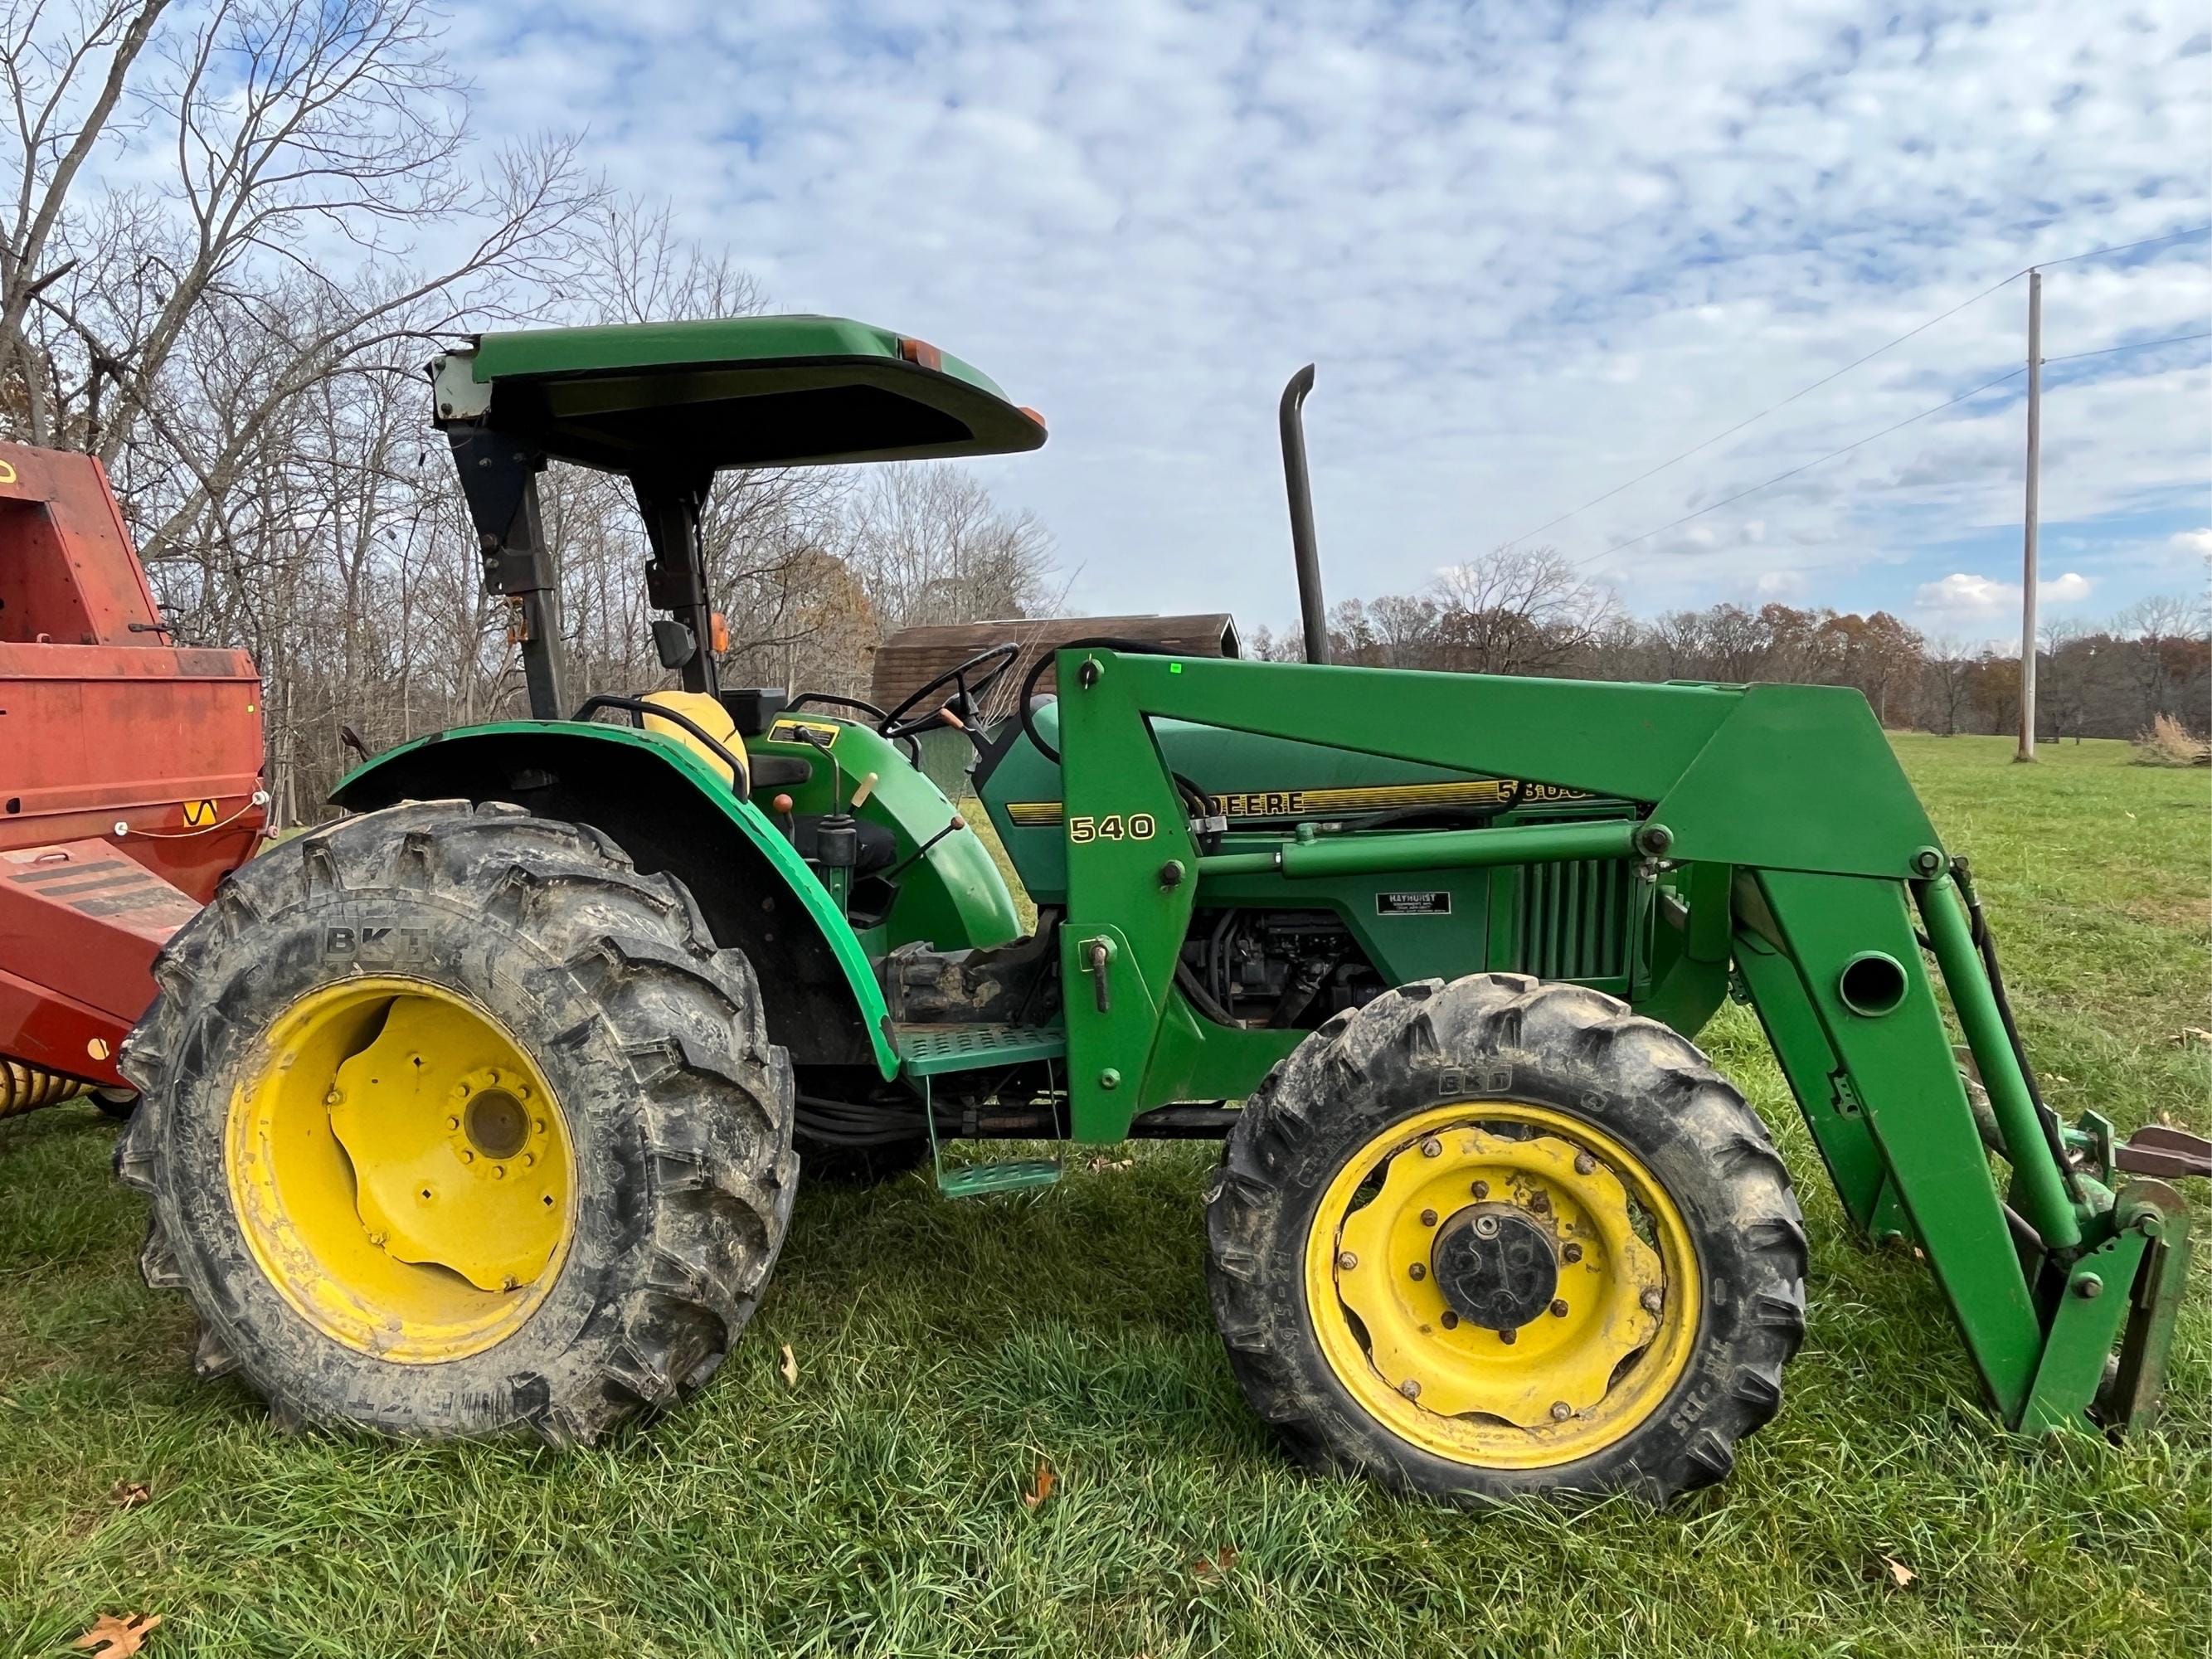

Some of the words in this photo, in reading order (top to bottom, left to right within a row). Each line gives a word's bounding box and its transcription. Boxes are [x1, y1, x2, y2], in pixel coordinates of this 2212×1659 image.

[1203, 791, 1305, 816] DEERE
[1070, 814, 1155, 844] 540
[325, 924, 430, 956] BKT
[1441, 1068, 1511, 1093] BKT
